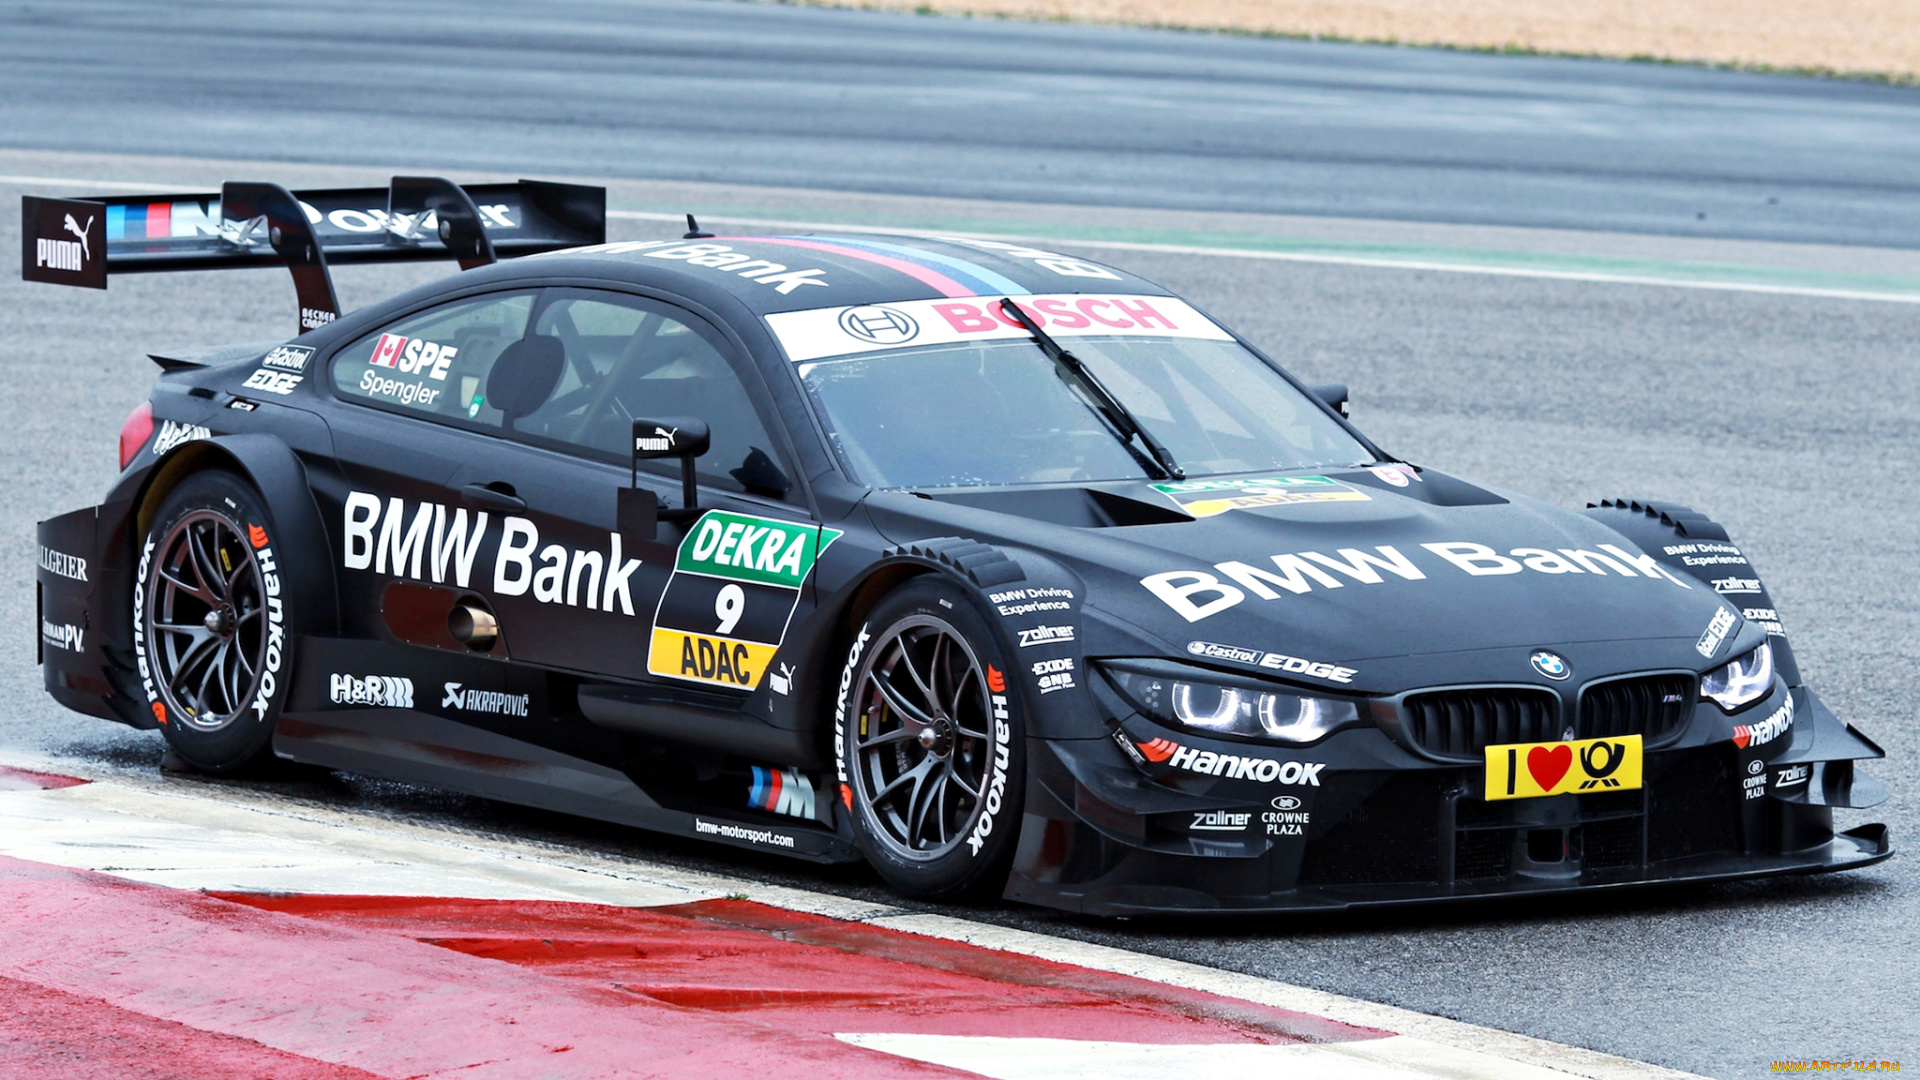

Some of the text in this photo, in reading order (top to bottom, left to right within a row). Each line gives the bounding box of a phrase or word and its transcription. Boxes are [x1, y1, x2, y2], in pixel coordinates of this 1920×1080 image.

[37, 238, 82, 271] PUMA
[643, 242, 829, 295] Bank
[302, 307, 336, 322] BECKER
[302, 318, 328, 329] CARB
[931, 299, 1179, 334] BOSCH
[271, 347, 310, 370] Castrol
[399, 338, 459, 380] SPE
[242, 369, 304, 395] EDGE
[360, 369, 440, 405] Spengler
[636, 437, 669, 451] PUMA
[344, 490, 643, 616] BMW Bank
[692, 519, 806, 577] DEKRA
[1663, 544, 1741, 556] BMW Driving
[1682, 555, 1747, 567] Experience
[989, 588, 1074, 604] BMW Driving
[1140, 541, 1692, 623] BMW Bank
[134, 532, 158, 702] Hankook
[715, 584, 745, 634] 9
[997, 601, 1071, 616] Experience
[1743, 608, 1778, 620] EXIDE
[250, 548, 284, 722] Hankook
[681, 636, 750, 686] ADAC
[1032, 658, 1075, 675] EXIDE
[1205, 645, 1359, 684] Castrol EDGE
[330, 673, 386, 706] H&R
[1038, 673, 1073, 688] GNB
[834, 622, 872, 783] Hankook
[966, 695, 1010, 857] Hankook
[1169, 746, 1326, 787] Hankook
[1506, 748, 1517, 795] I
[1743, 773, 1767, 789] CROWNE
[1746, 787, 1765, 800] PLAZA
[696, 818, 794, 848] bmw-motorsport.com
[1261, 812, 1310, 824] CROWNE
[1267, 824, 1303, 835] PLAZA
